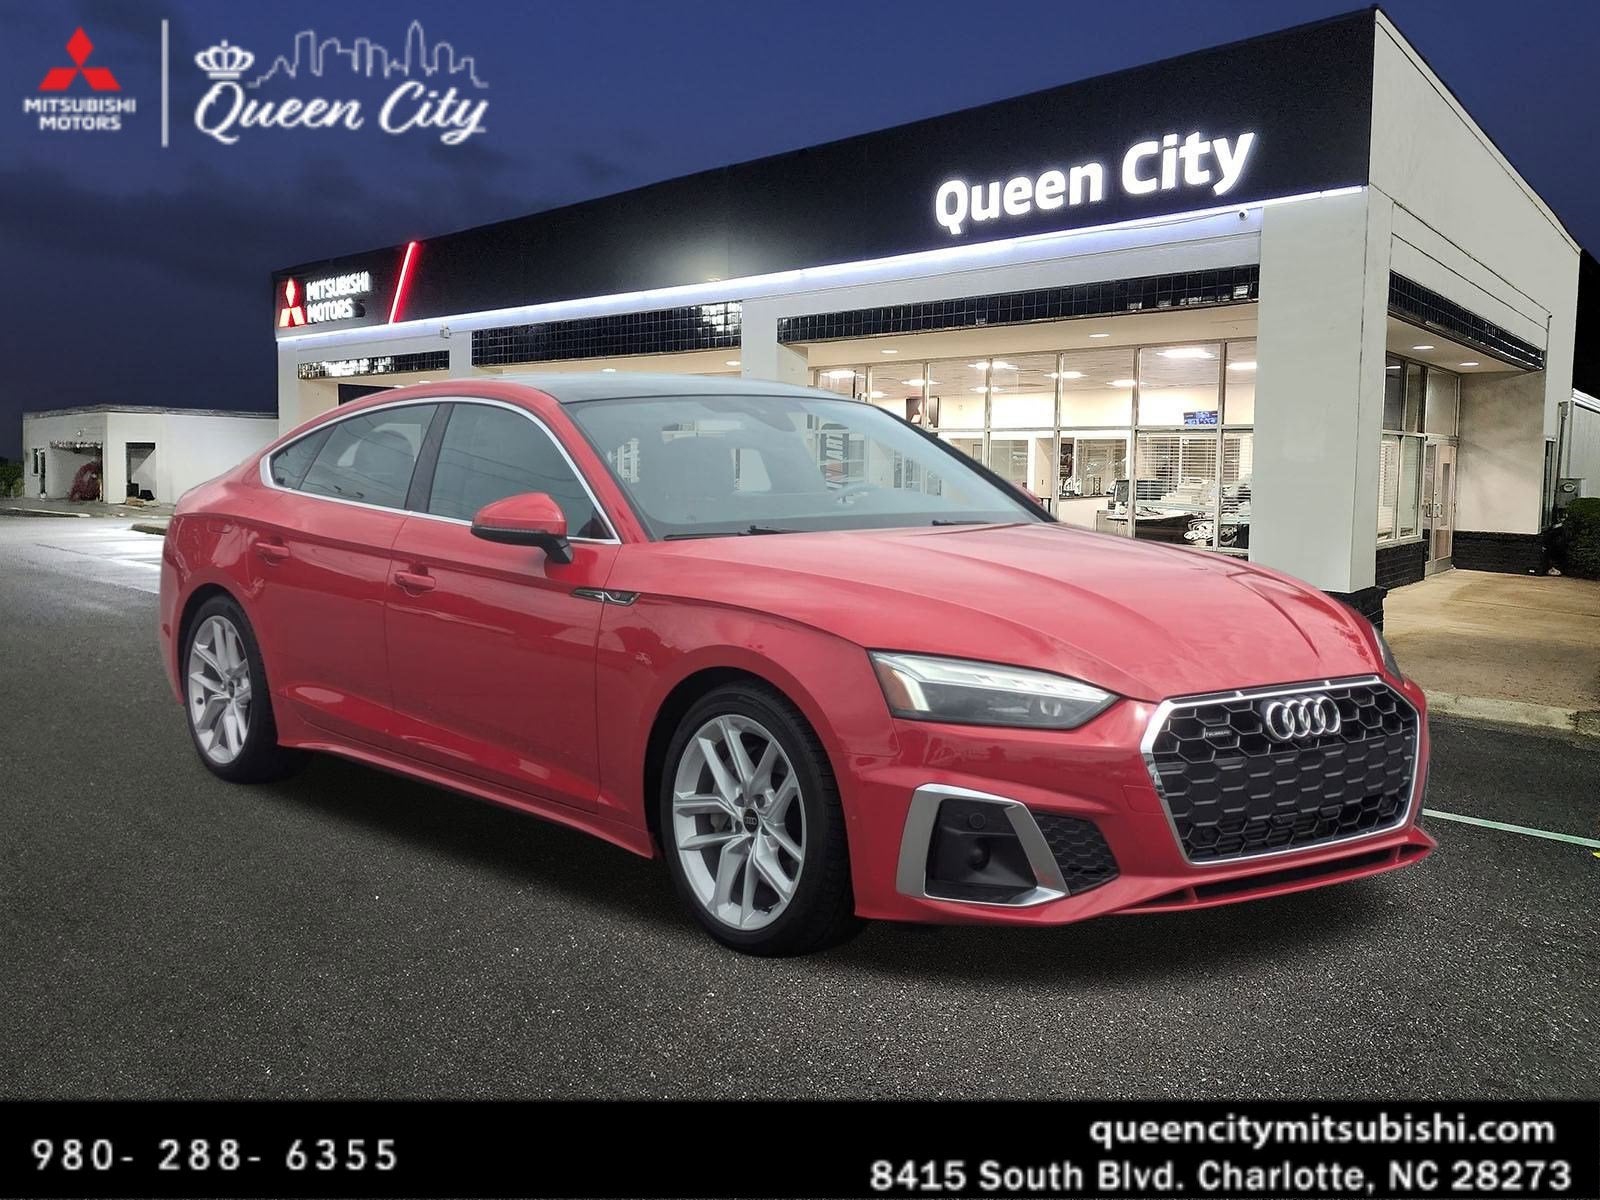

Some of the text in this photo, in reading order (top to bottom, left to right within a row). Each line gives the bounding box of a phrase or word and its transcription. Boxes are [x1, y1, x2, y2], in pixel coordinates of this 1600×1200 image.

[935, 131, 1255, 235] Queen City
[306, 271, 369, 301] MITSUBISHI
[306, 297, 353, 323] MOTORS
